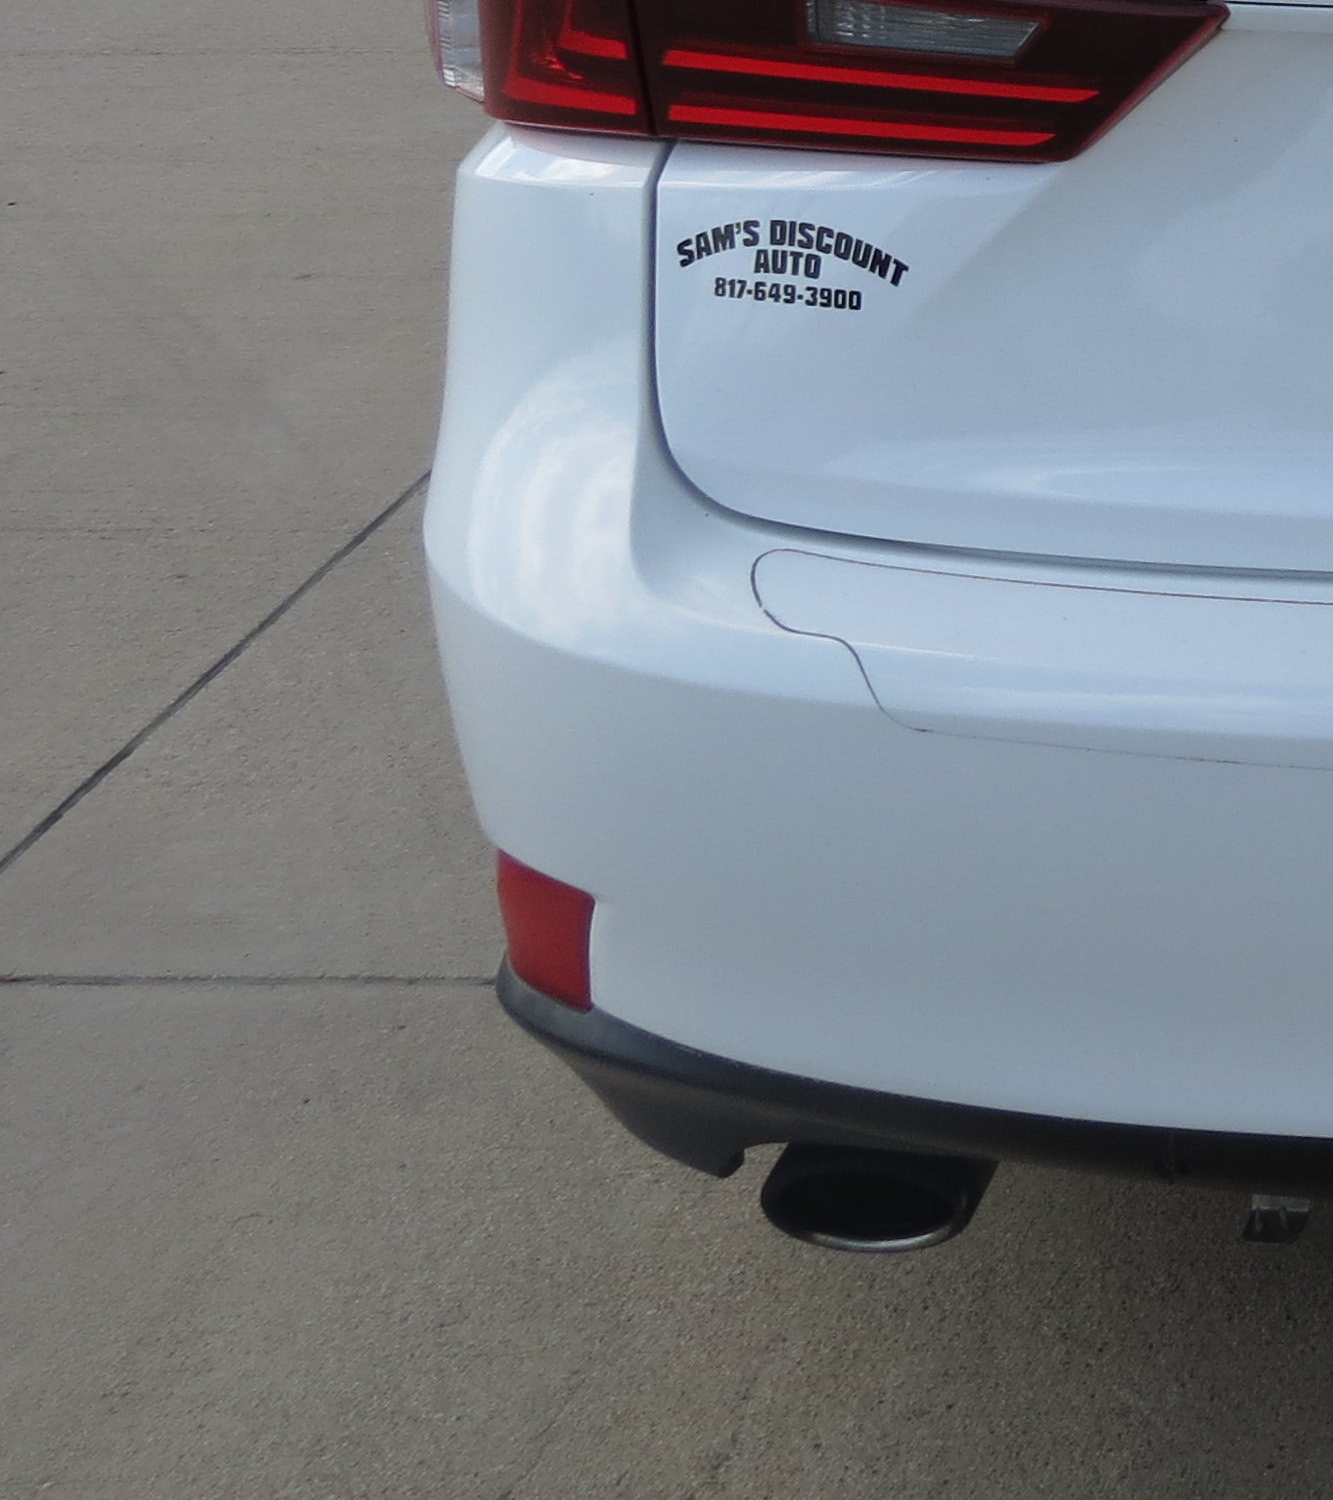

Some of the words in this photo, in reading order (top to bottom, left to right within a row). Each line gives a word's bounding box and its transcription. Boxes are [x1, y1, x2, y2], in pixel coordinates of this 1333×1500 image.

[676, 220, 761, 267] SAM'S
[769, 219, 909, 287] DISCOUNT
[753, 249, 822, 279] AUTO
[713, 276, 862, 311] 817-649-3900
